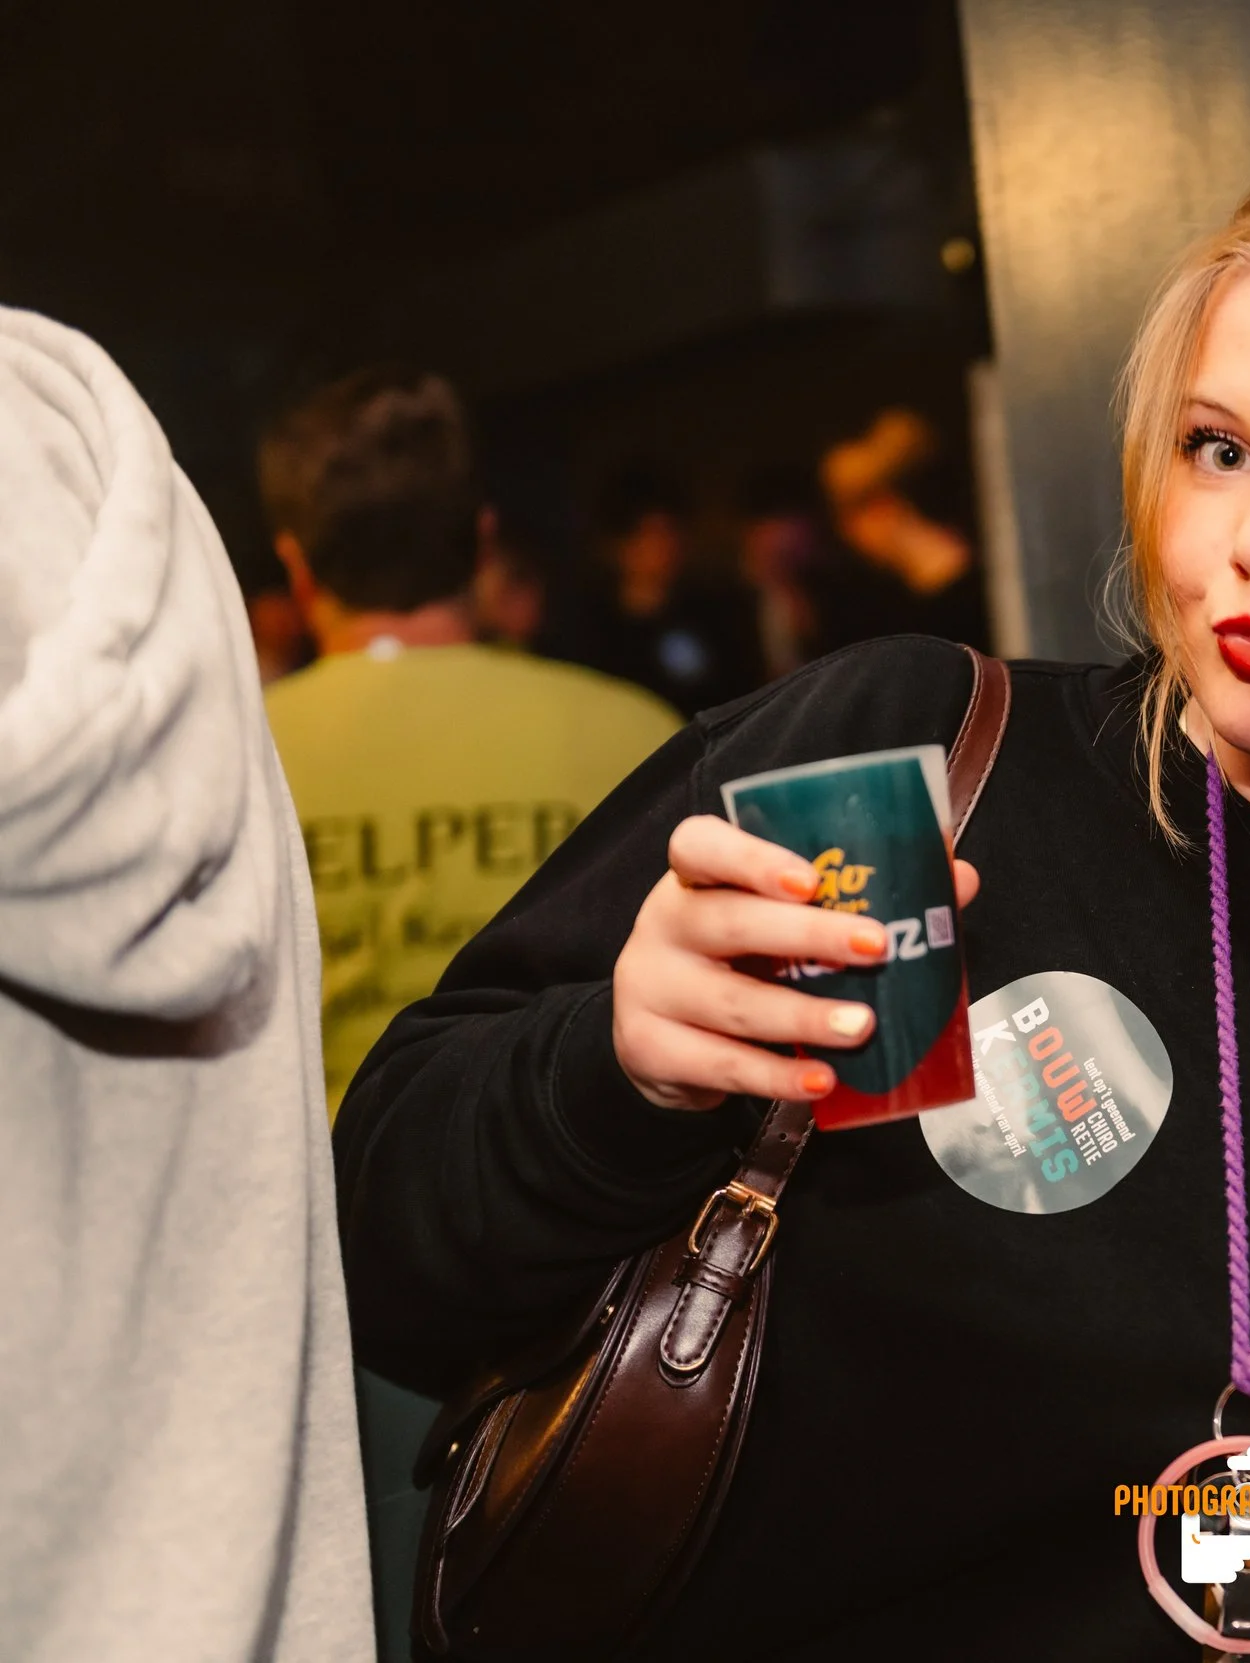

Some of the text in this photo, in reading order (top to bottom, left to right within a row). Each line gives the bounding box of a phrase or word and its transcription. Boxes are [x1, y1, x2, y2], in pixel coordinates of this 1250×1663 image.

[812, 847, 877, 900] Go
[974, 1019, 1080, 1183] KERMIS
[1012, 997, 1098, 1123] BOUW
[1083, 1057, 1098, 1080] tent
[1101, 1096, 1136, 1143] geenend
[974, 1069, 1028, 1158] weekend van april
[1070, 1121, 1102, 1167] RETIE
[1087, 1111, 1119, 1154] CHIRO
